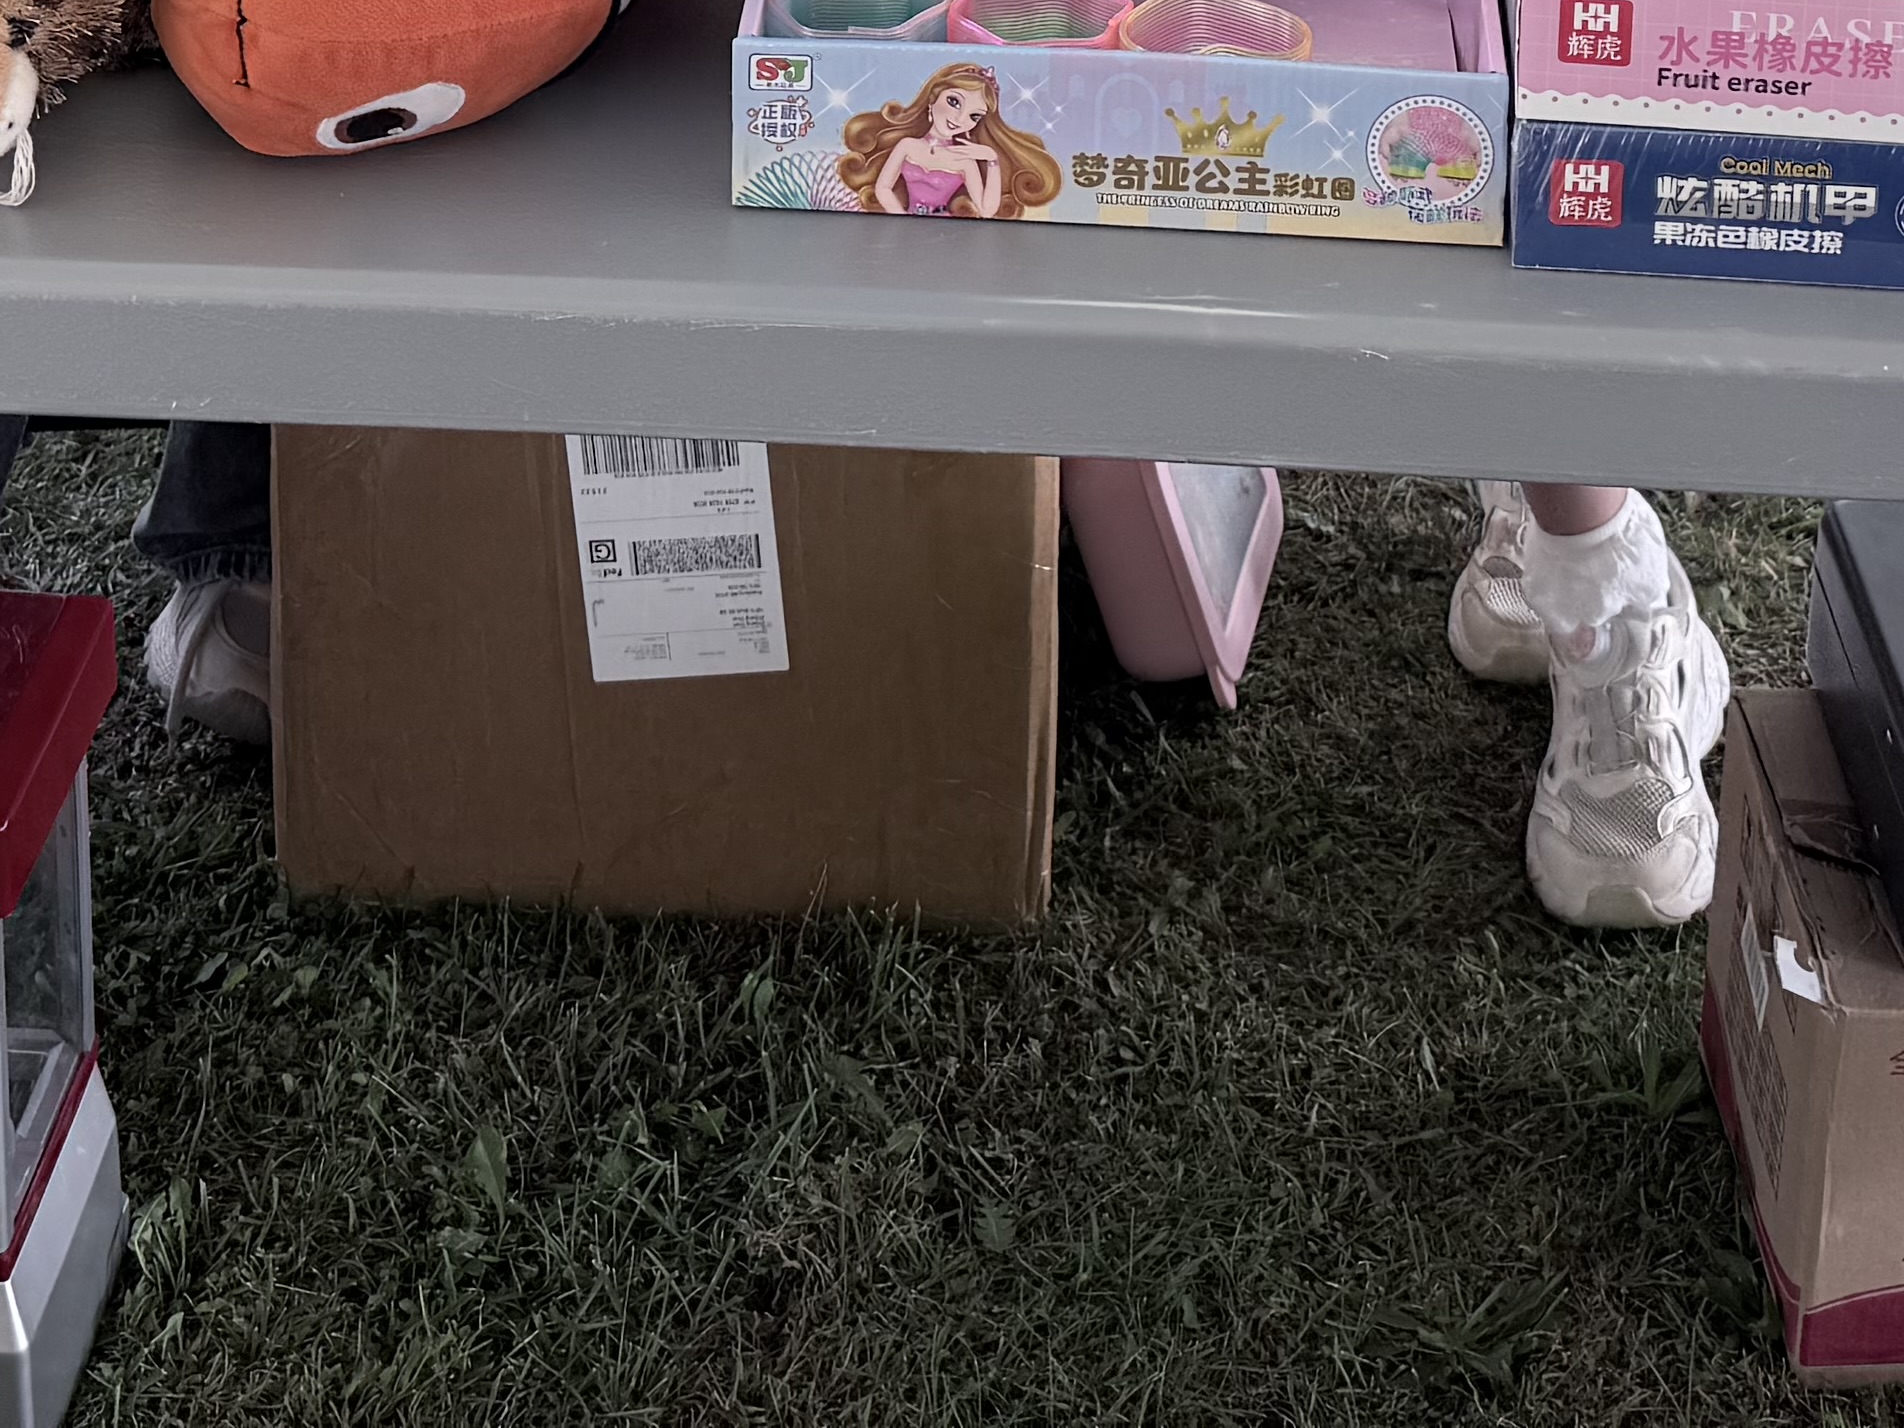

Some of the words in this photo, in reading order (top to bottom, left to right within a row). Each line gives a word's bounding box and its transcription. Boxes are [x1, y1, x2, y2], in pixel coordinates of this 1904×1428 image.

[1573, 1, 1621, 33] HH
[1566, 34, 1624, 63] 辉虎
[1657, 25, 1894, 81] 水果橡皮擦
[1657, 67, 1721, 92] Fruit
[1726, 76, 1813, 97] eraser
[761, 103, 799, 121] 正版
[1563, 162, 1610, 194] HH
[1774, 159, 1833, 180] Mech
[1558, 194, 1613, 222] 辉虎
[1654, 175, 1880, 226] 炫酷机甲
[1652, 220, 1845, 256] 果冻色橡皮擦
[594, 544, 612, 561] G
